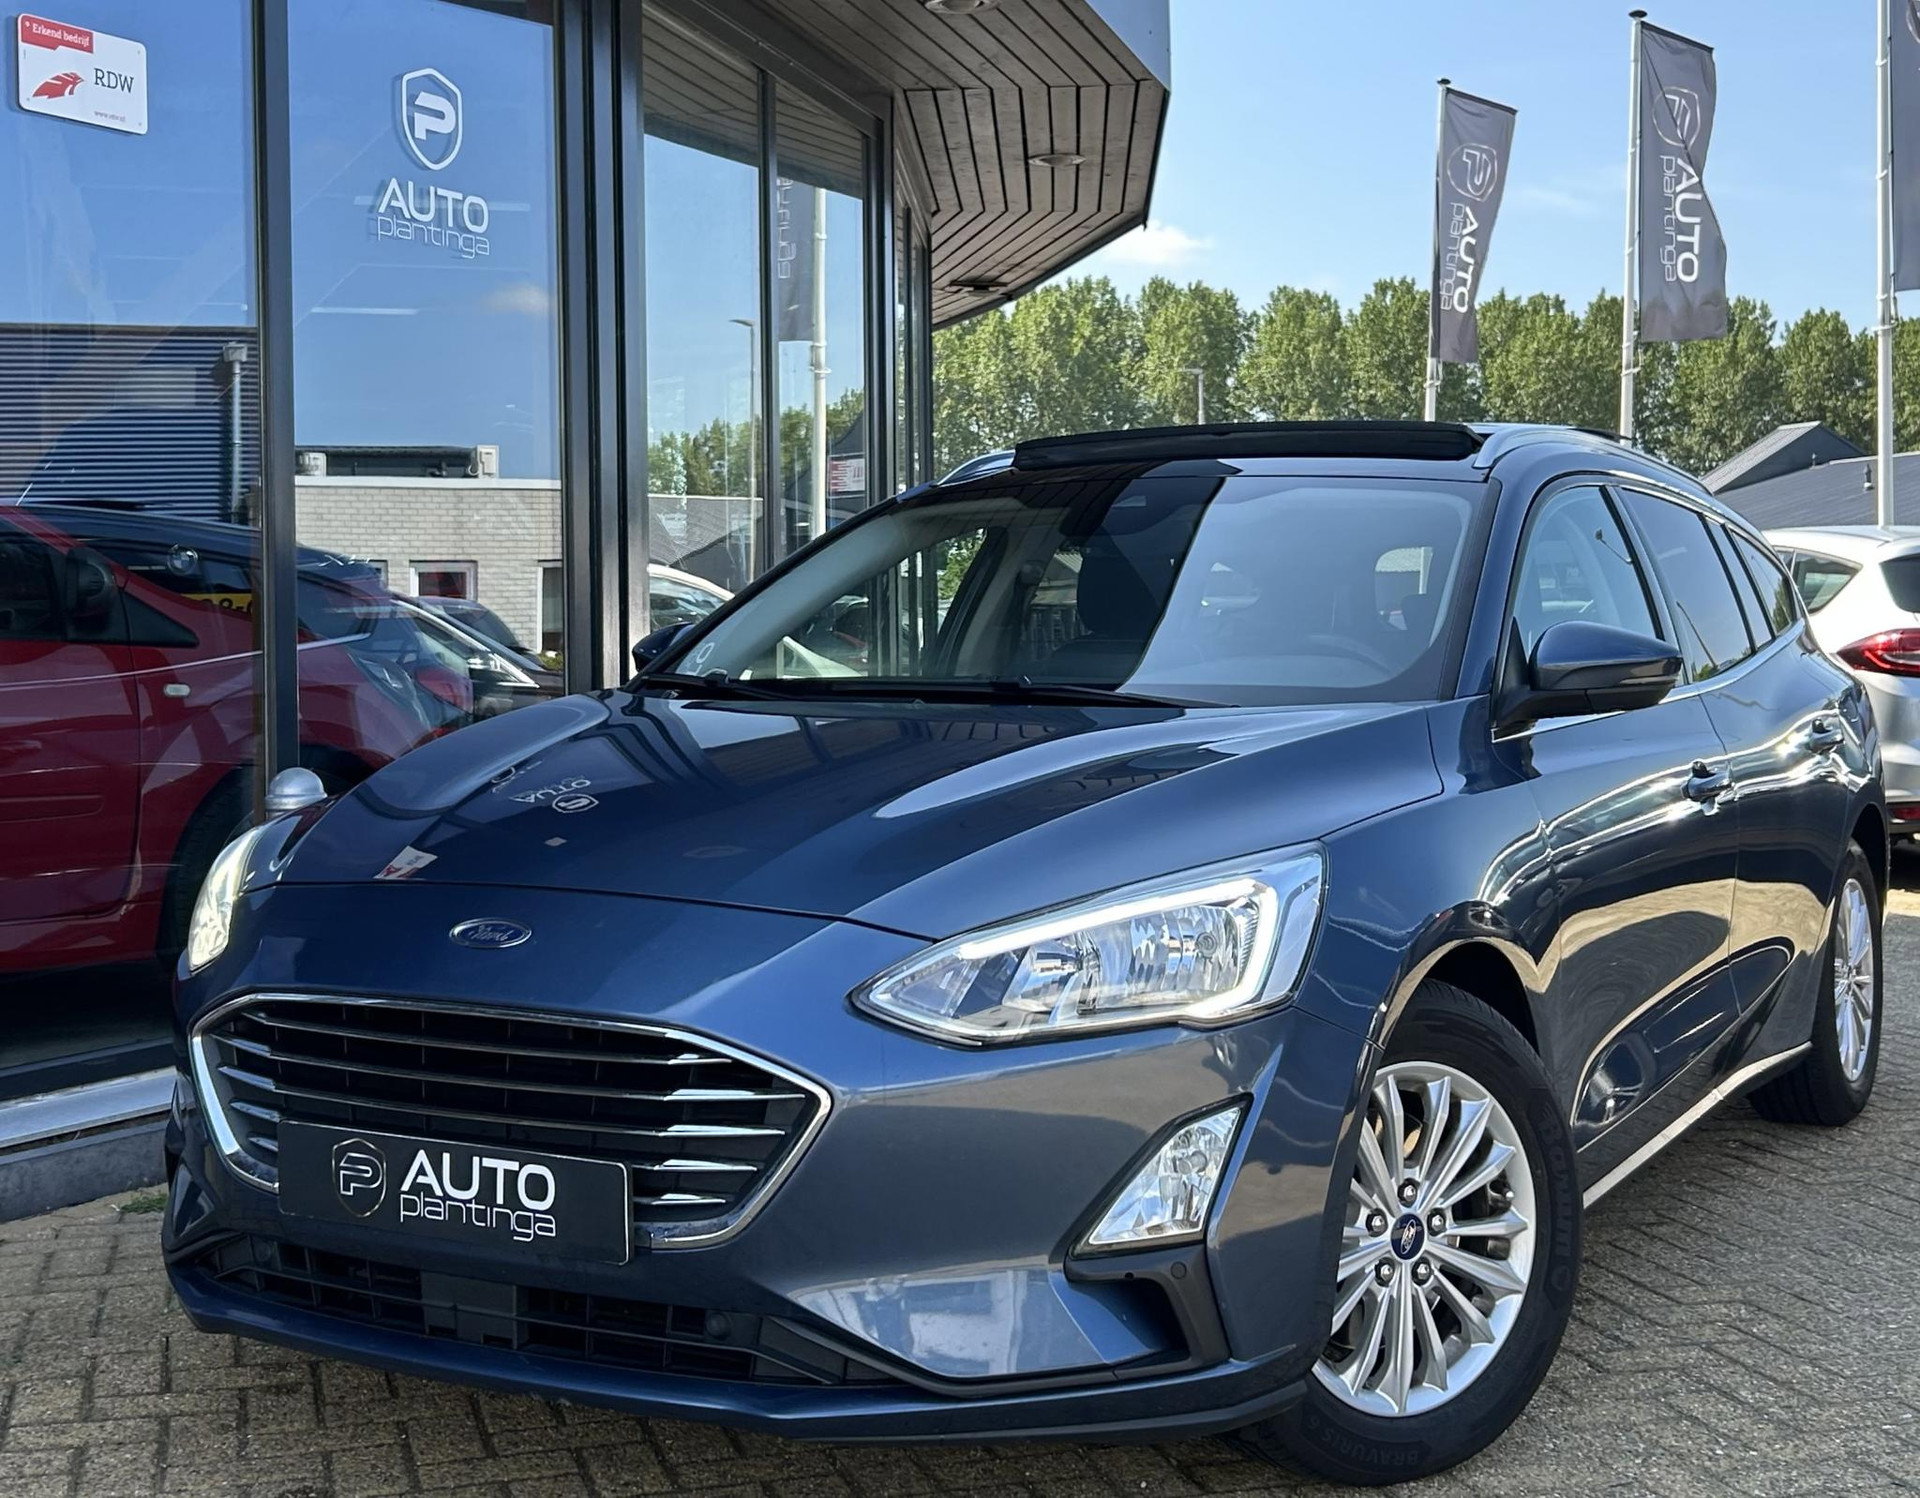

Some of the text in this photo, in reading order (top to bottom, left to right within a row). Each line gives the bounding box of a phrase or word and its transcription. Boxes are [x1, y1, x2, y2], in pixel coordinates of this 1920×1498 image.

[32, 23, 90, 48] Erkend bedrijf
[94, 67, 135, 94] RDW
[378, 177, 489, 233] AUTO
[1659, 155, 1678, 282] plantinga
[1675, 156, 1702, 283] AUTO
[377, 215, 490, 259] plantinga
[1440, 202, 1465, 310] plantinga
[1453, 205, 1479, 314] AUTO
[468, 924, 515, 942] Ford
[400, 1149, 556, 1211] AUTO
[400, 1191, 556, 1242] plantinga
[1319, 1428, 1419, 1466] BRAVURIS
